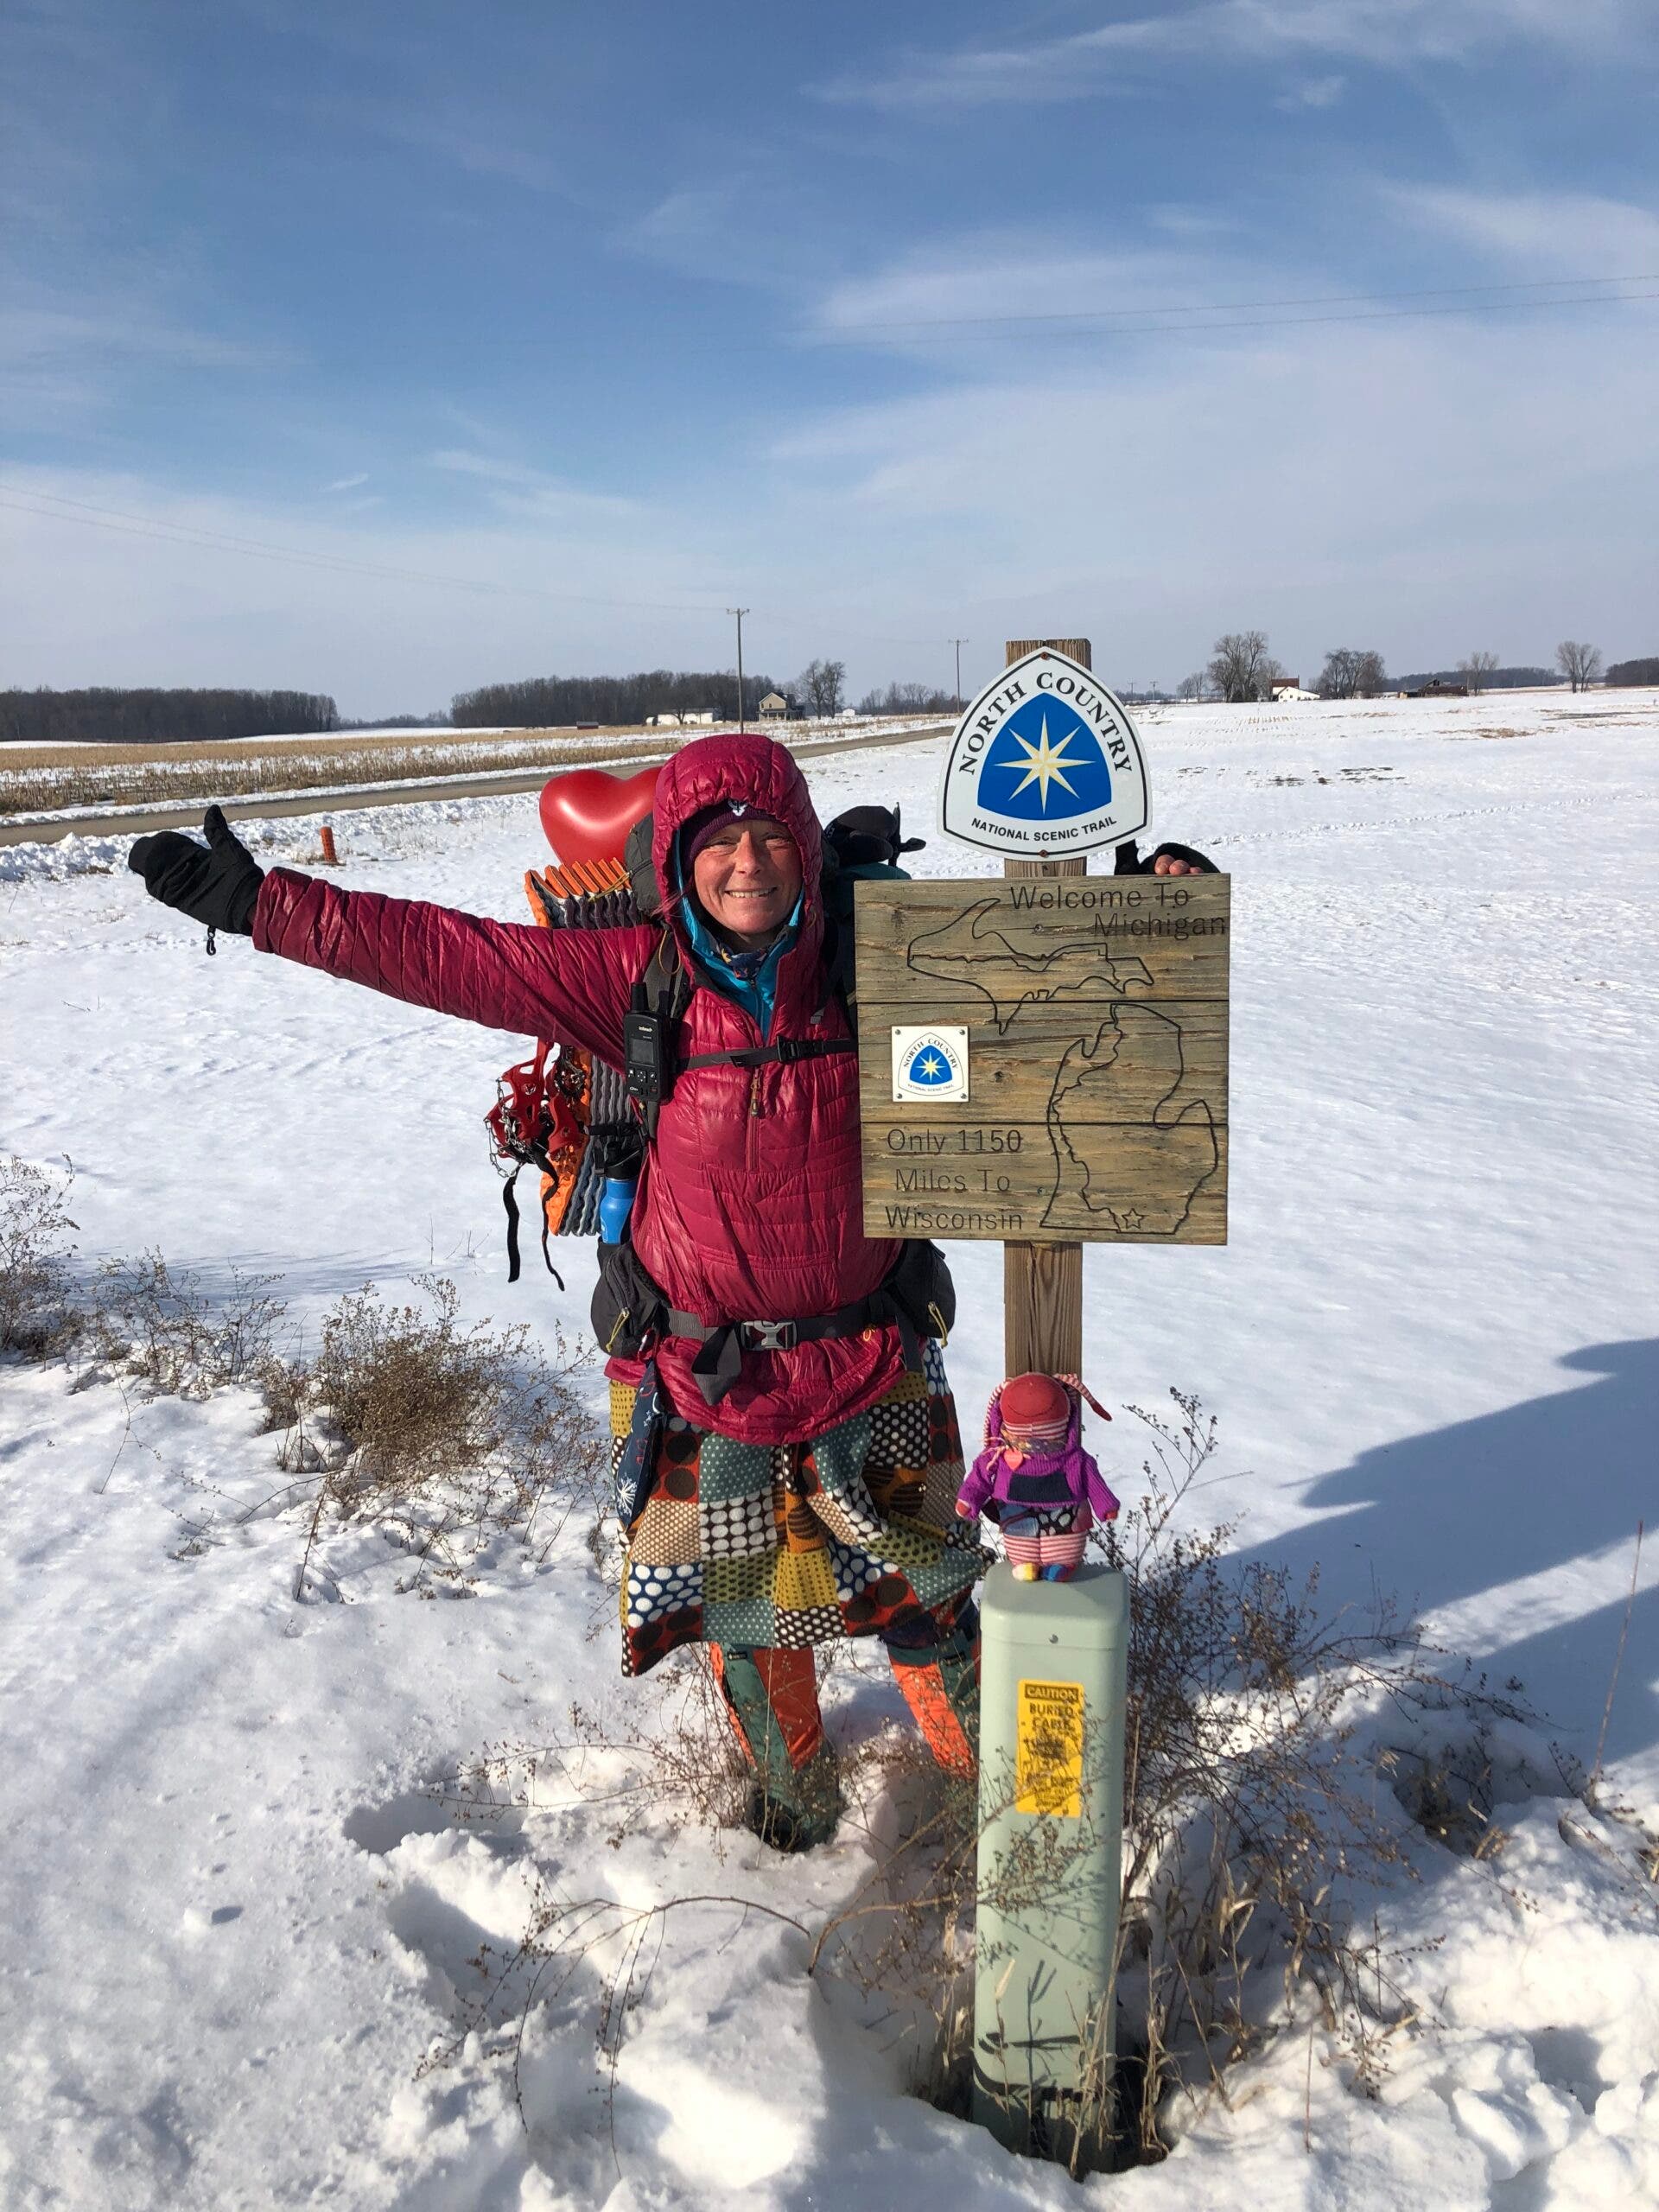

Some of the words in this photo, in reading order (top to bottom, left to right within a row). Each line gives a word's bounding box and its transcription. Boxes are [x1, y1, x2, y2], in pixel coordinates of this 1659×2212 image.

[959, 680, 1027, 775] NORTH
[1036, 672, 1132, 772] COUNTRY
[971, 817, 1029, 841] NATIONAL
[1033, 828, 1079, 842] SCENIC
[1082, 816, 1117, 835] TRAIL
[1010, 885, 1141, 909] Welcome
[1154, 883, 1189, 907] To
[1094, 912, 1226, 941] Michigan
[903, 1041, 925, 1068] NORTH
[927, 1038, 958, 1069] COUNTRY
[887, 1128, 946, 1155] Only
[957, 1129, 1022, 1152] 1150
[895, 1169, 967, 1193] Miles
[976, 1169, 1010, 1192] To
[885, 1206, 1023, 1230] Wisconsin
[1027, 1685, 1077, 1701] CAUTION
